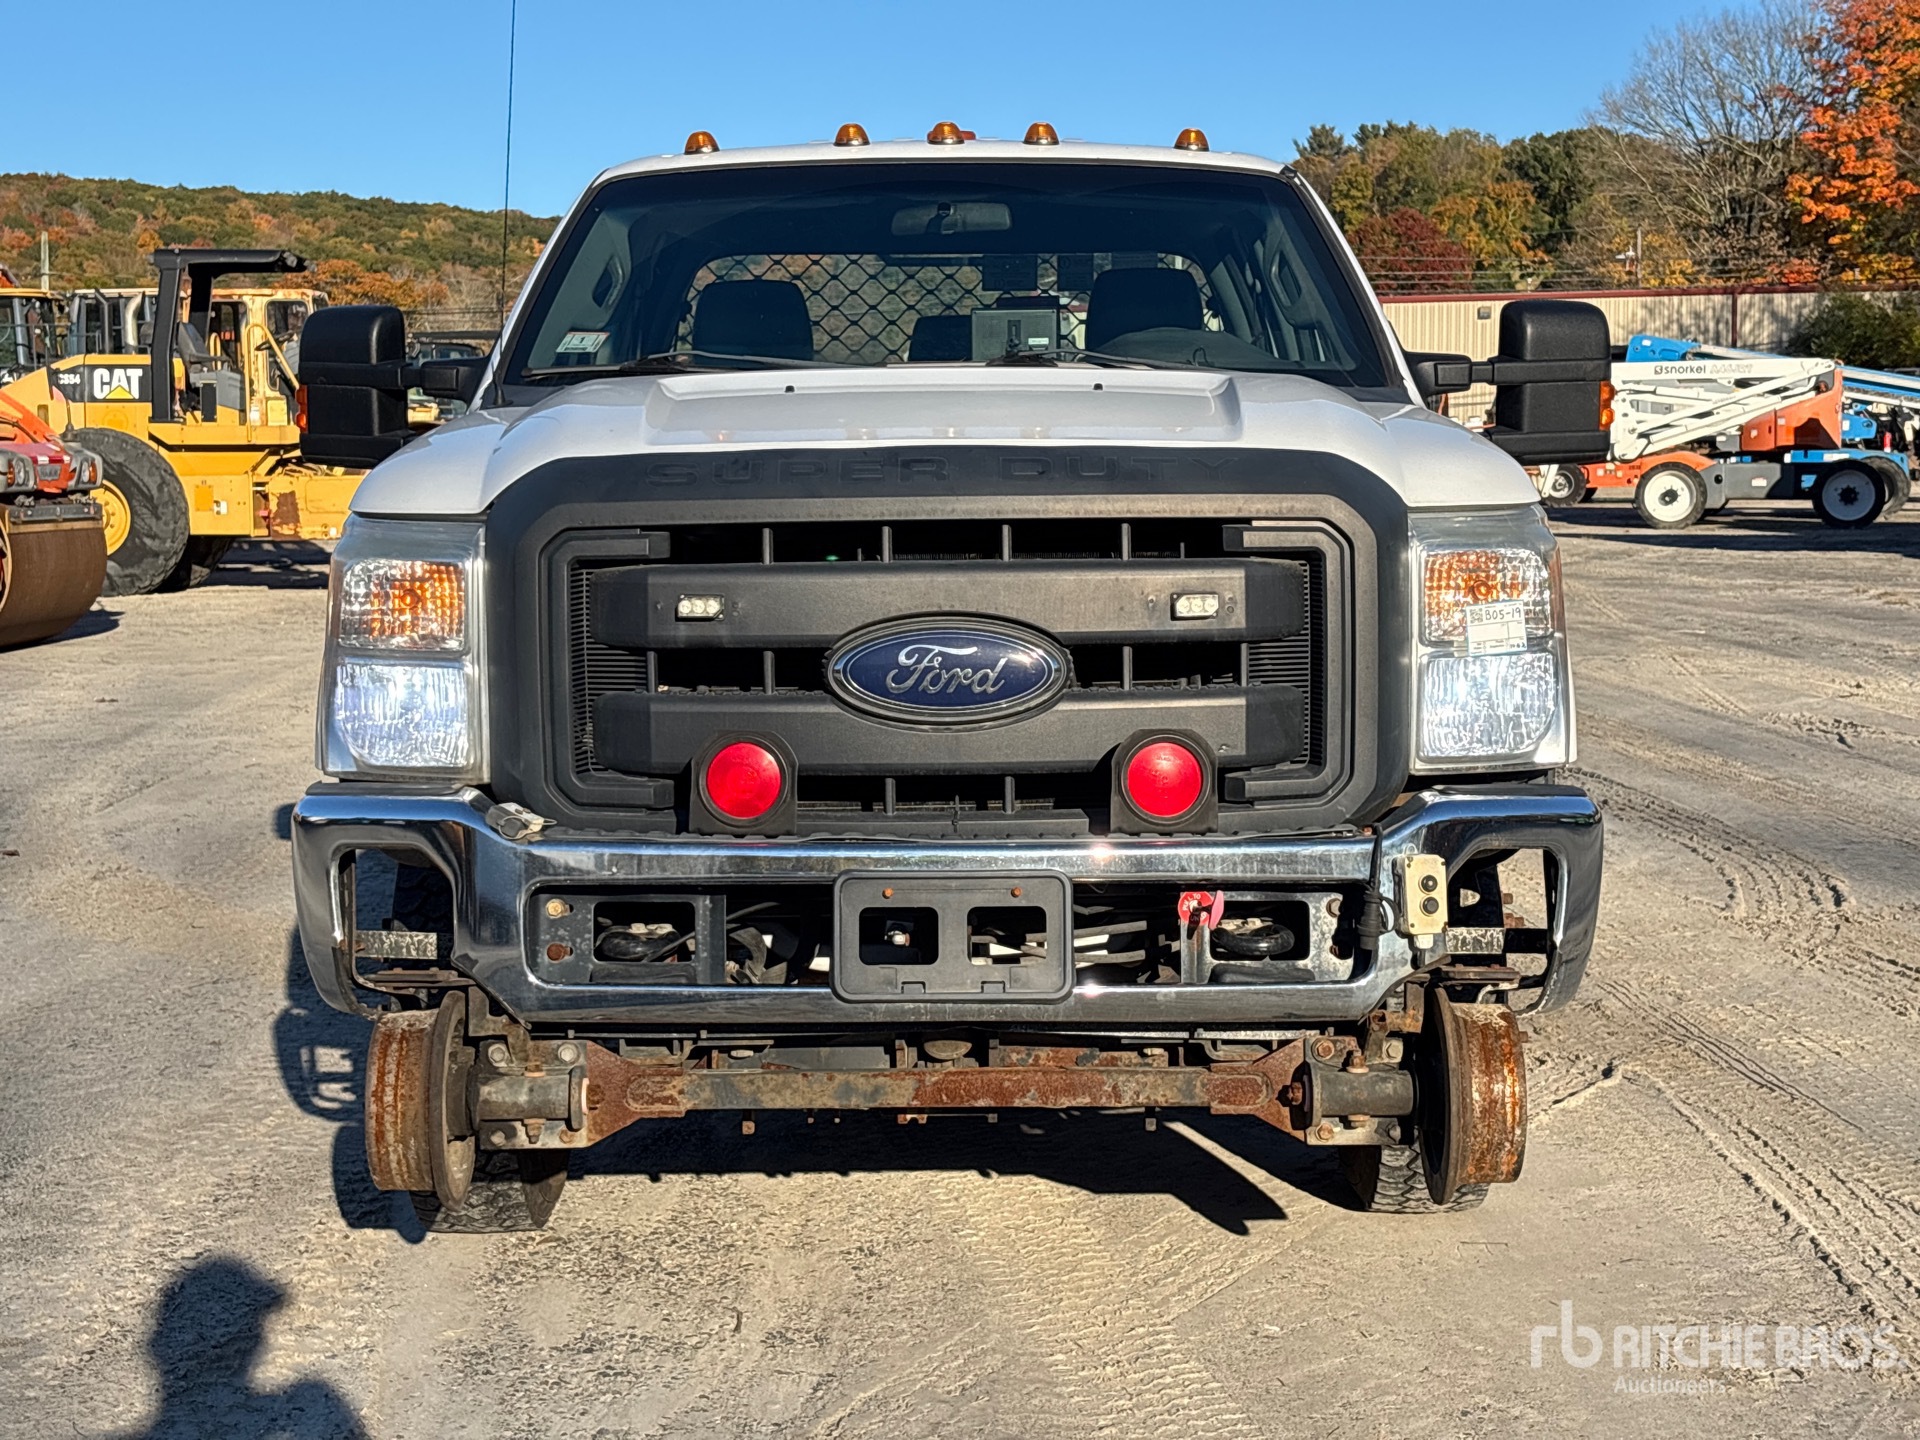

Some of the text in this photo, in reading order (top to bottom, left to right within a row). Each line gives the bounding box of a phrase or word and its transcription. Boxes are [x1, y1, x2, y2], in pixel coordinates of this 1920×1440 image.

[93, 367, 143, 400] CAT
[1664, 365, 1706, 374] snorkel
[646, 456, 1240, 486] SUPER DUTY
[885, 644, 1009, 694] Ford
